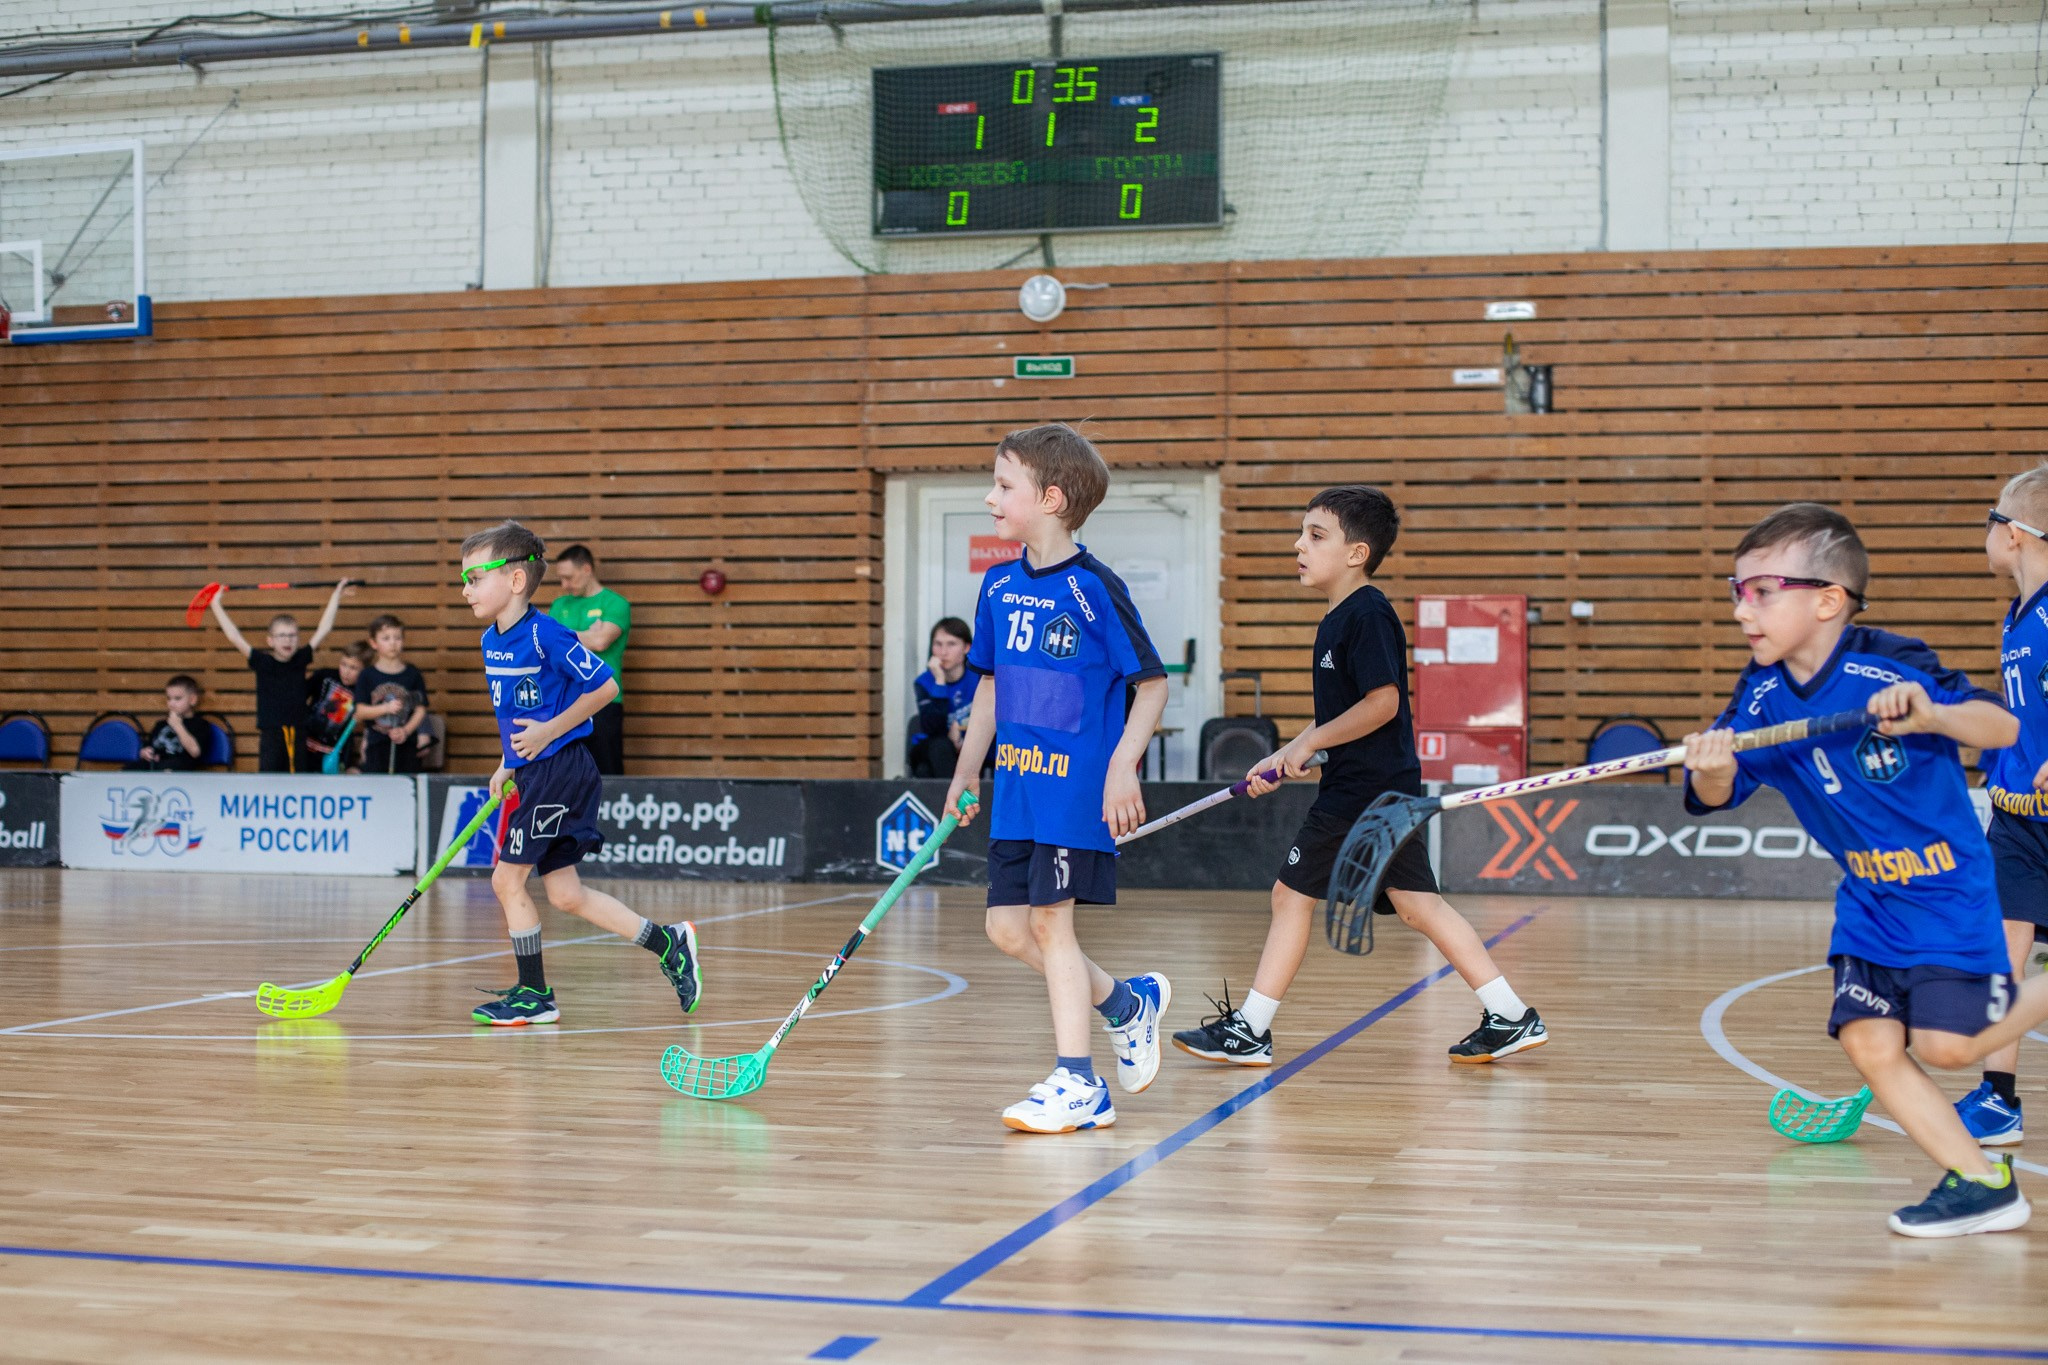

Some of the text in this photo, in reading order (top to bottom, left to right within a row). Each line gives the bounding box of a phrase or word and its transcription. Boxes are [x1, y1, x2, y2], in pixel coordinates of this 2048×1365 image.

[975, 115, 985, 150] 1
[1046, 112, 1056, 147] 1
[1135, 107, 1159, 143] 2
[946, 191, 970, 225] 0
[1119, 184, 1143, 219] 0
[1002, 592, 1056, 610] GIVOVA
[1006, 610, 1035, 653] 15
[2004, 664, 2026, 708] 11
[1812, 747, 1842, 795] 9
[220, 794, 372, 820] МИНСПОРТ
[240, 827, 350, 853] РОССИИ
[510, 827, 524, 855] 29
